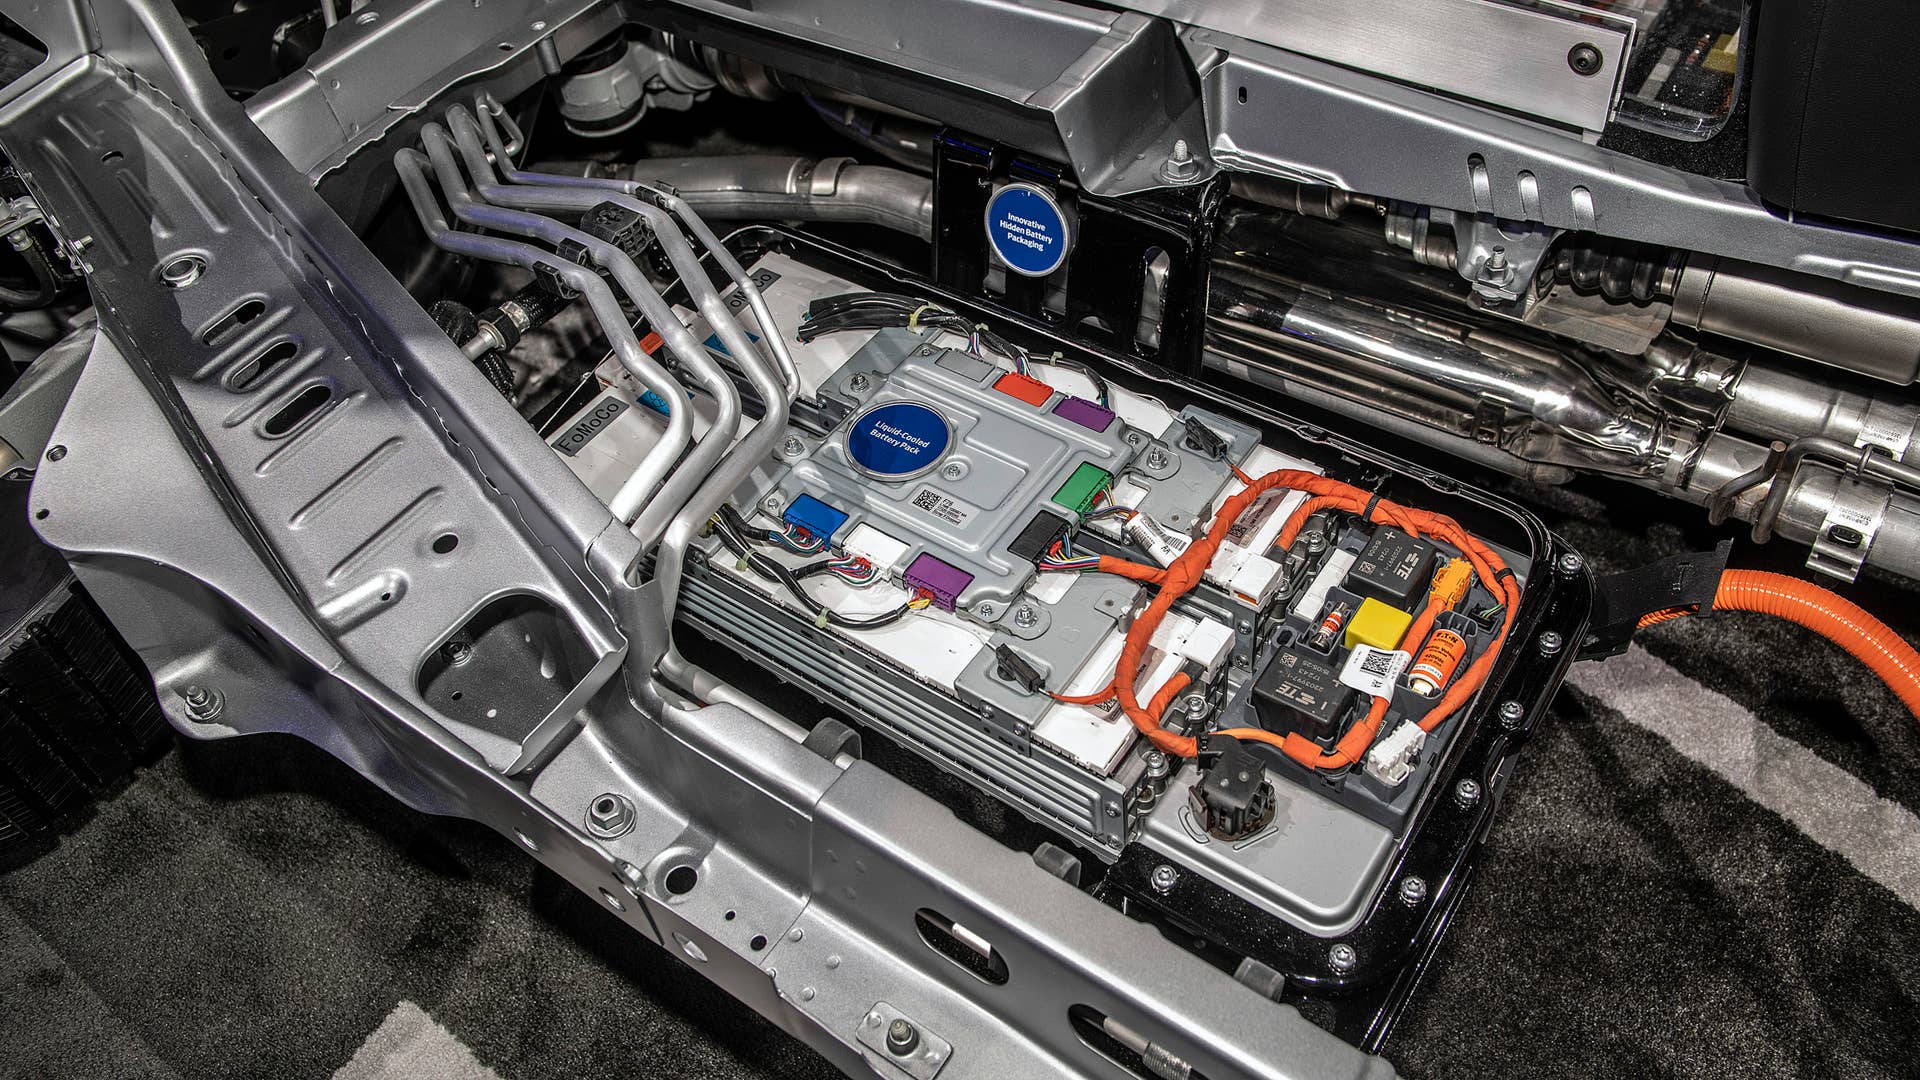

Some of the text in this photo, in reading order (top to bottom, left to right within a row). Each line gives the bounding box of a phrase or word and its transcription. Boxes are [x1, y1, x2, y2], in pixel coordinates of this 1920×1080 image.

[1000, 219, 1053, 245] Hidden Battery
[1008, 212, 1046, 232] Innovative
[1007, 232, 1044, 252] Packaging
[558, 403, 619, 452] FoMoCo
[875, 420, 930, 448] Liquid-Cooled
[870, 428, 920, 455] Battery Pack
